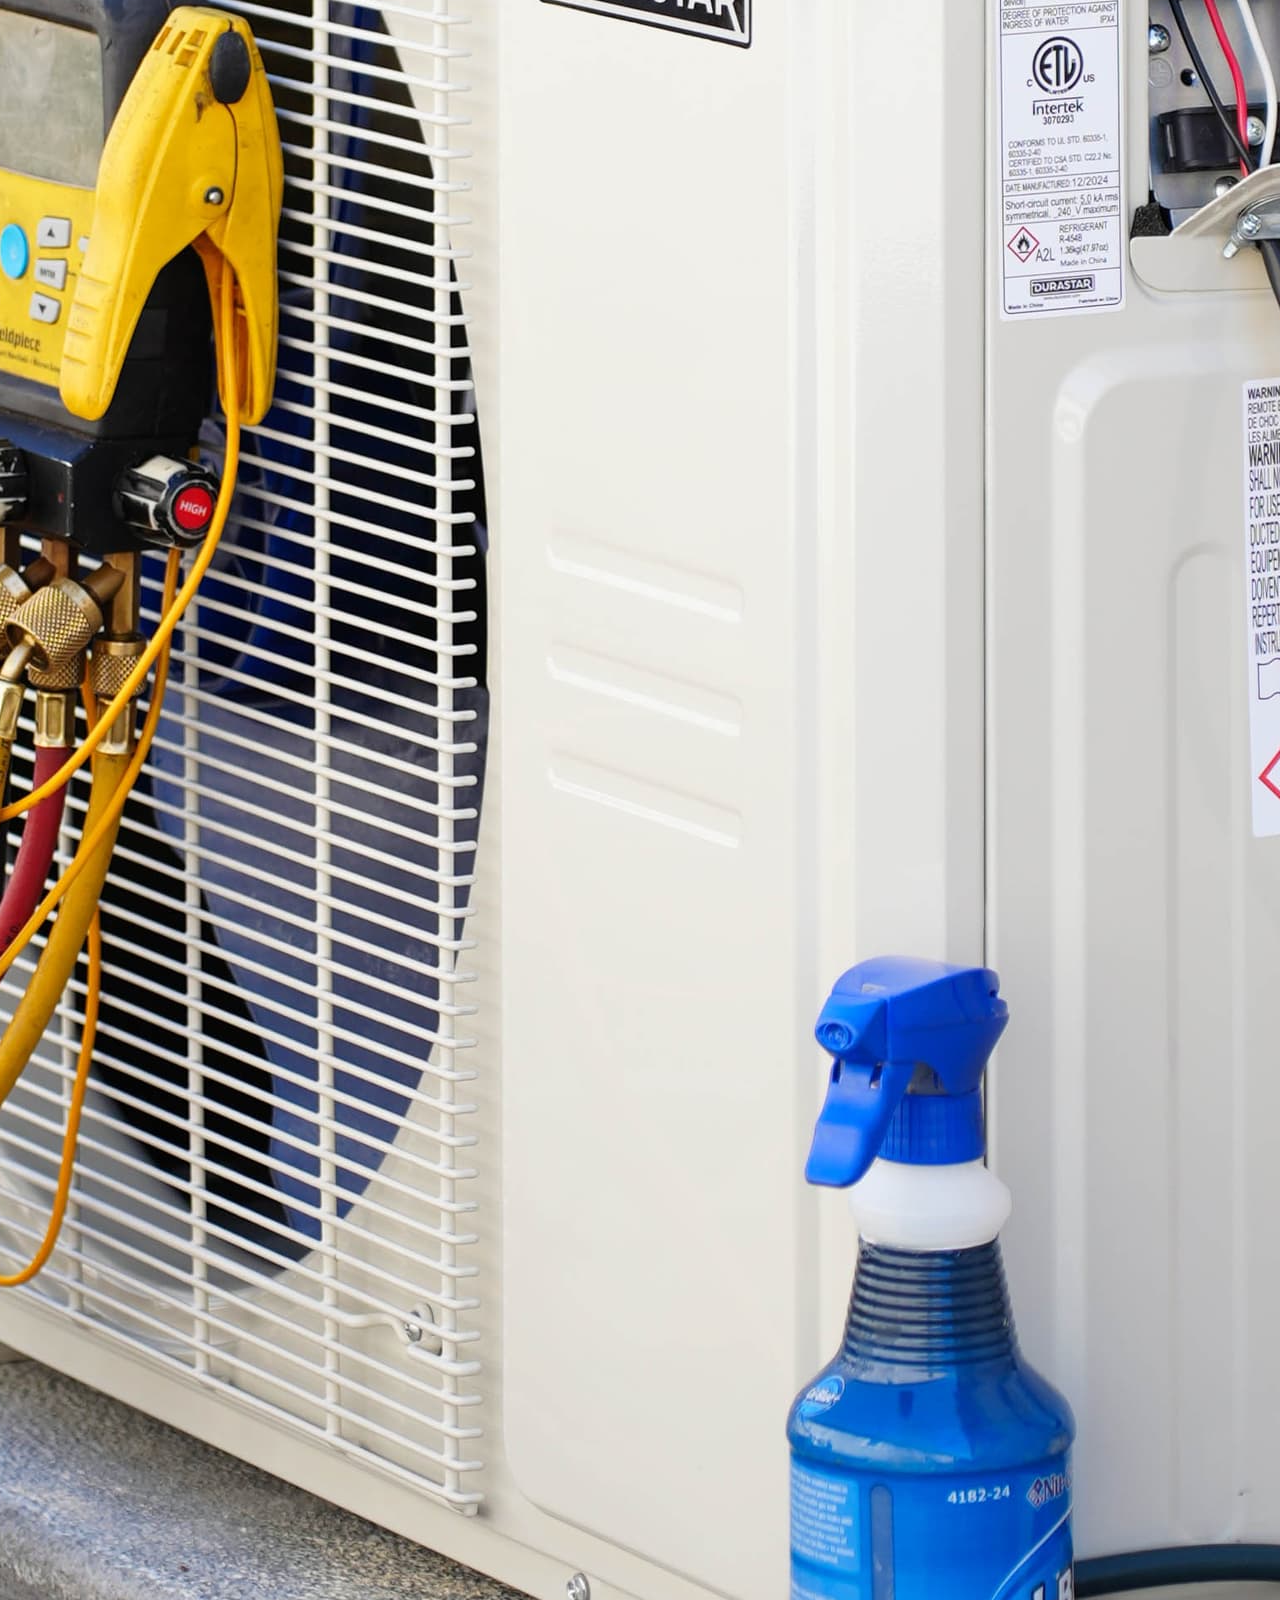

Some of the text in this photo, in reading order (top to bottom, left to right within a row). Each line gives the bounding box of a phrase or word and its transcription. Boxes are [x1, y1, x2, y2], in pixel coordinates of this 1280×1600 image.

[1002, 3, 1117, 20] DEGREE OF PROTECTION AGAINST
[1003, 16, 1070, 30] INGRESS OF WATER
[1084, 74, 1095, 83] US
[1033, 98, 1084, 116] Intertek
[1043, 114, 1075, 126] 3070293
[1008, 138, 1045, 150] CONFORMS
[1048, 137, 1056, 146] TO
[1008, 155, 1067, 168] CERTIFIED TO CSA
[1006, 175, 1109, 193] DATE 12/2024
[1083, 203, 1118, 215] maximum
[1059, 221, 1108, 234] REFRIGERANT
[1036, 247, 1056, 263] A2L
[1061, 259, 1079, 267] Made
[1089, 256, 1107, 265] China
[1032, 277, 1092, 294] DURASTAR
[1248, 400, 1276, 414] REMOTE
[1248, 417, 1257, 429] DE
[1260, 414, 1278, 428] CHOC
[1248, 430, 1261, 443] LES
[1249, 467, 1272, 491] SHALL
[180, 501, 207, 517] HIGH
[1250, 495, 1265, 518] FOR
[1266, 493, 1280, 516] USE
[1250, 520, 1279, 545] DUCTED
